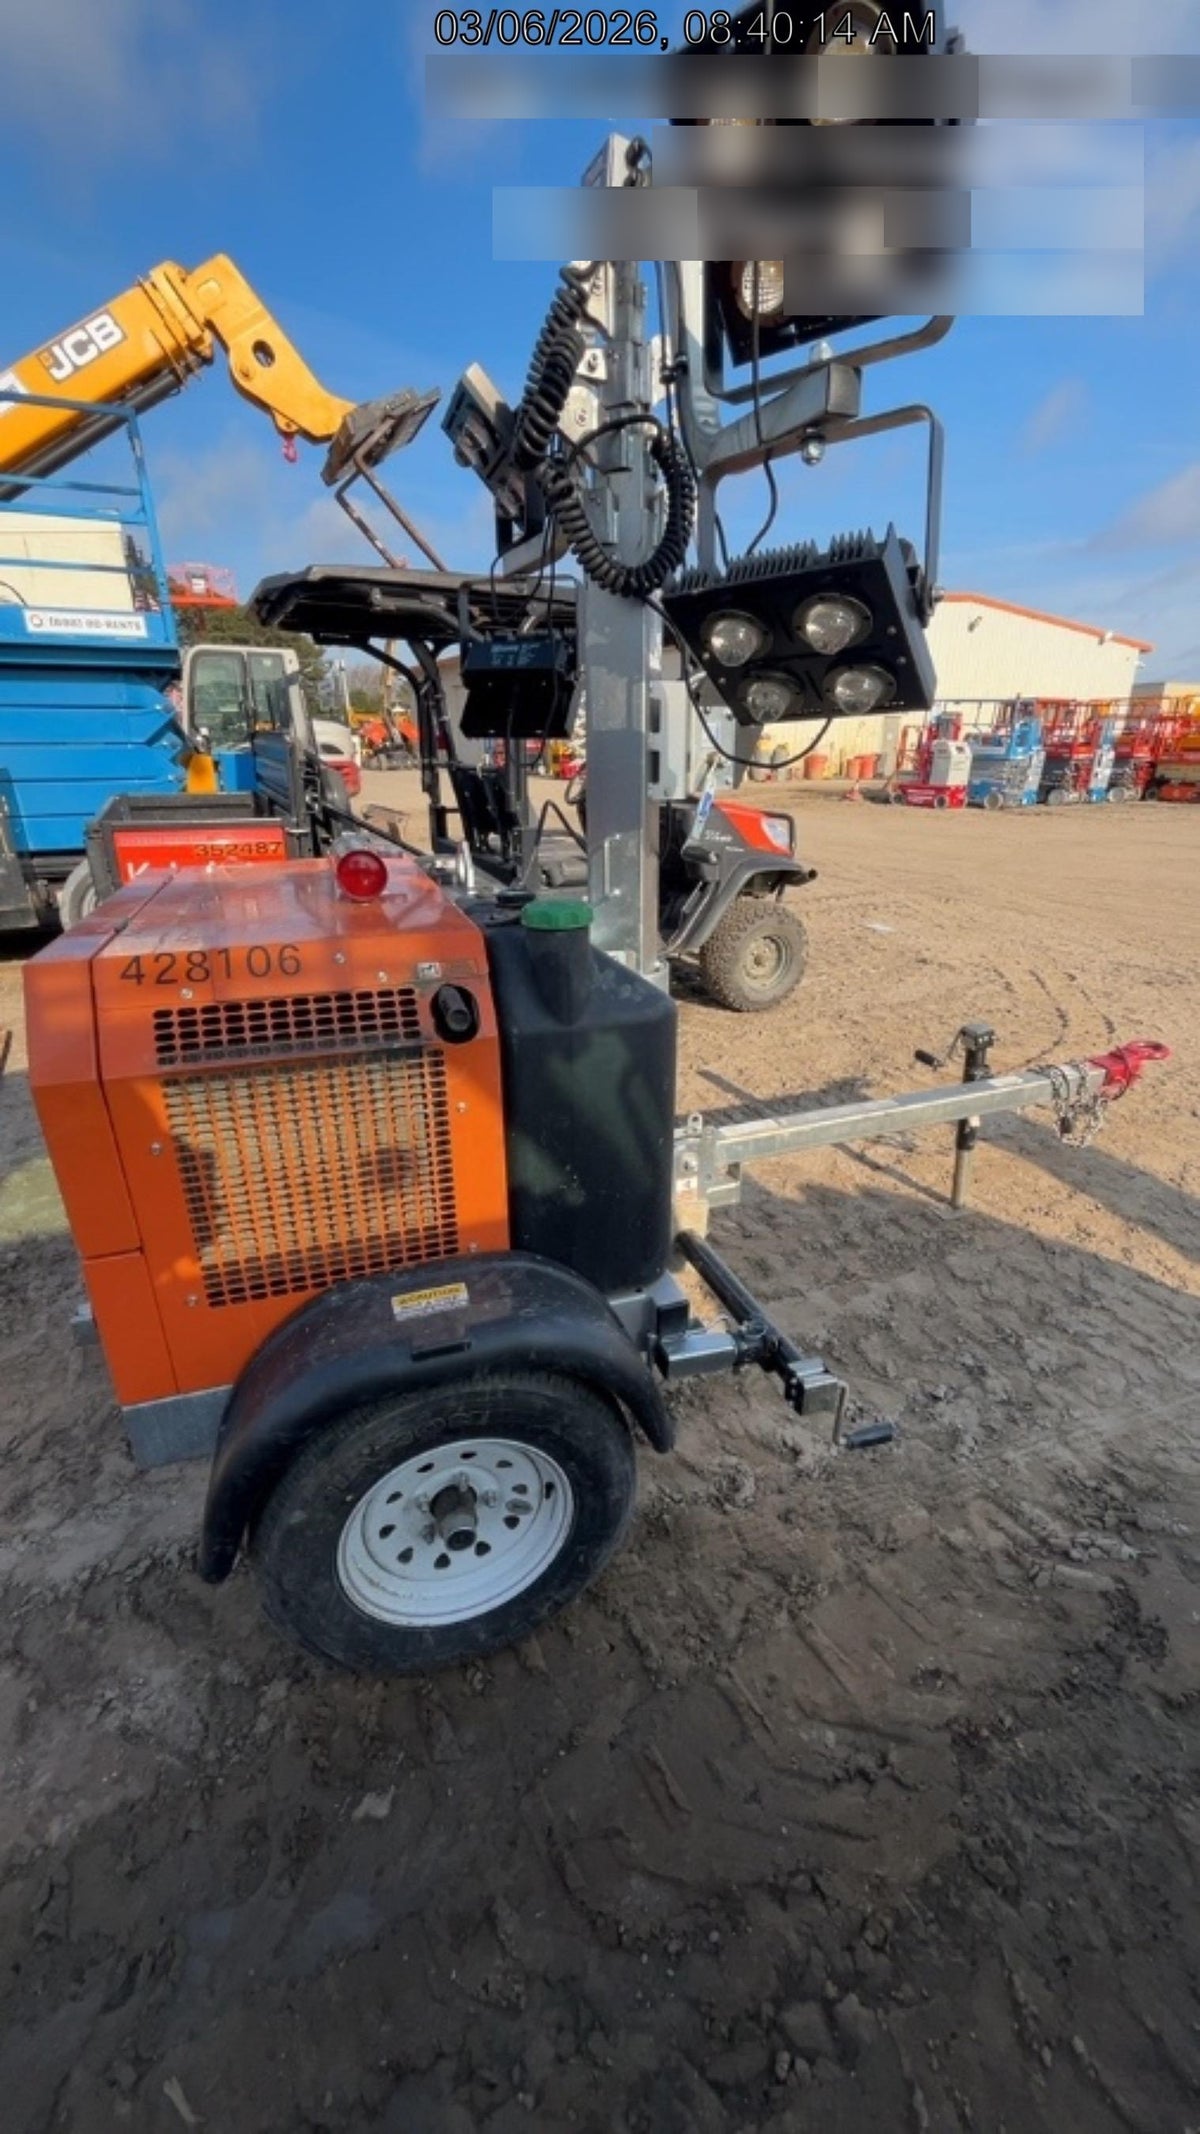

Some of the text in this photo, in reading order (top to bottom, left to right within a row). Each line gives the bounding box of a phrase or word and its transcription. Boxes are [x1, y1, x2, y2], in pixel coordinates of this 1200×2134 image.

[49, 314, 123, 380] JCB
[194, 841, 283, 857] 352487
[120, 944, 302, 986] 428106
